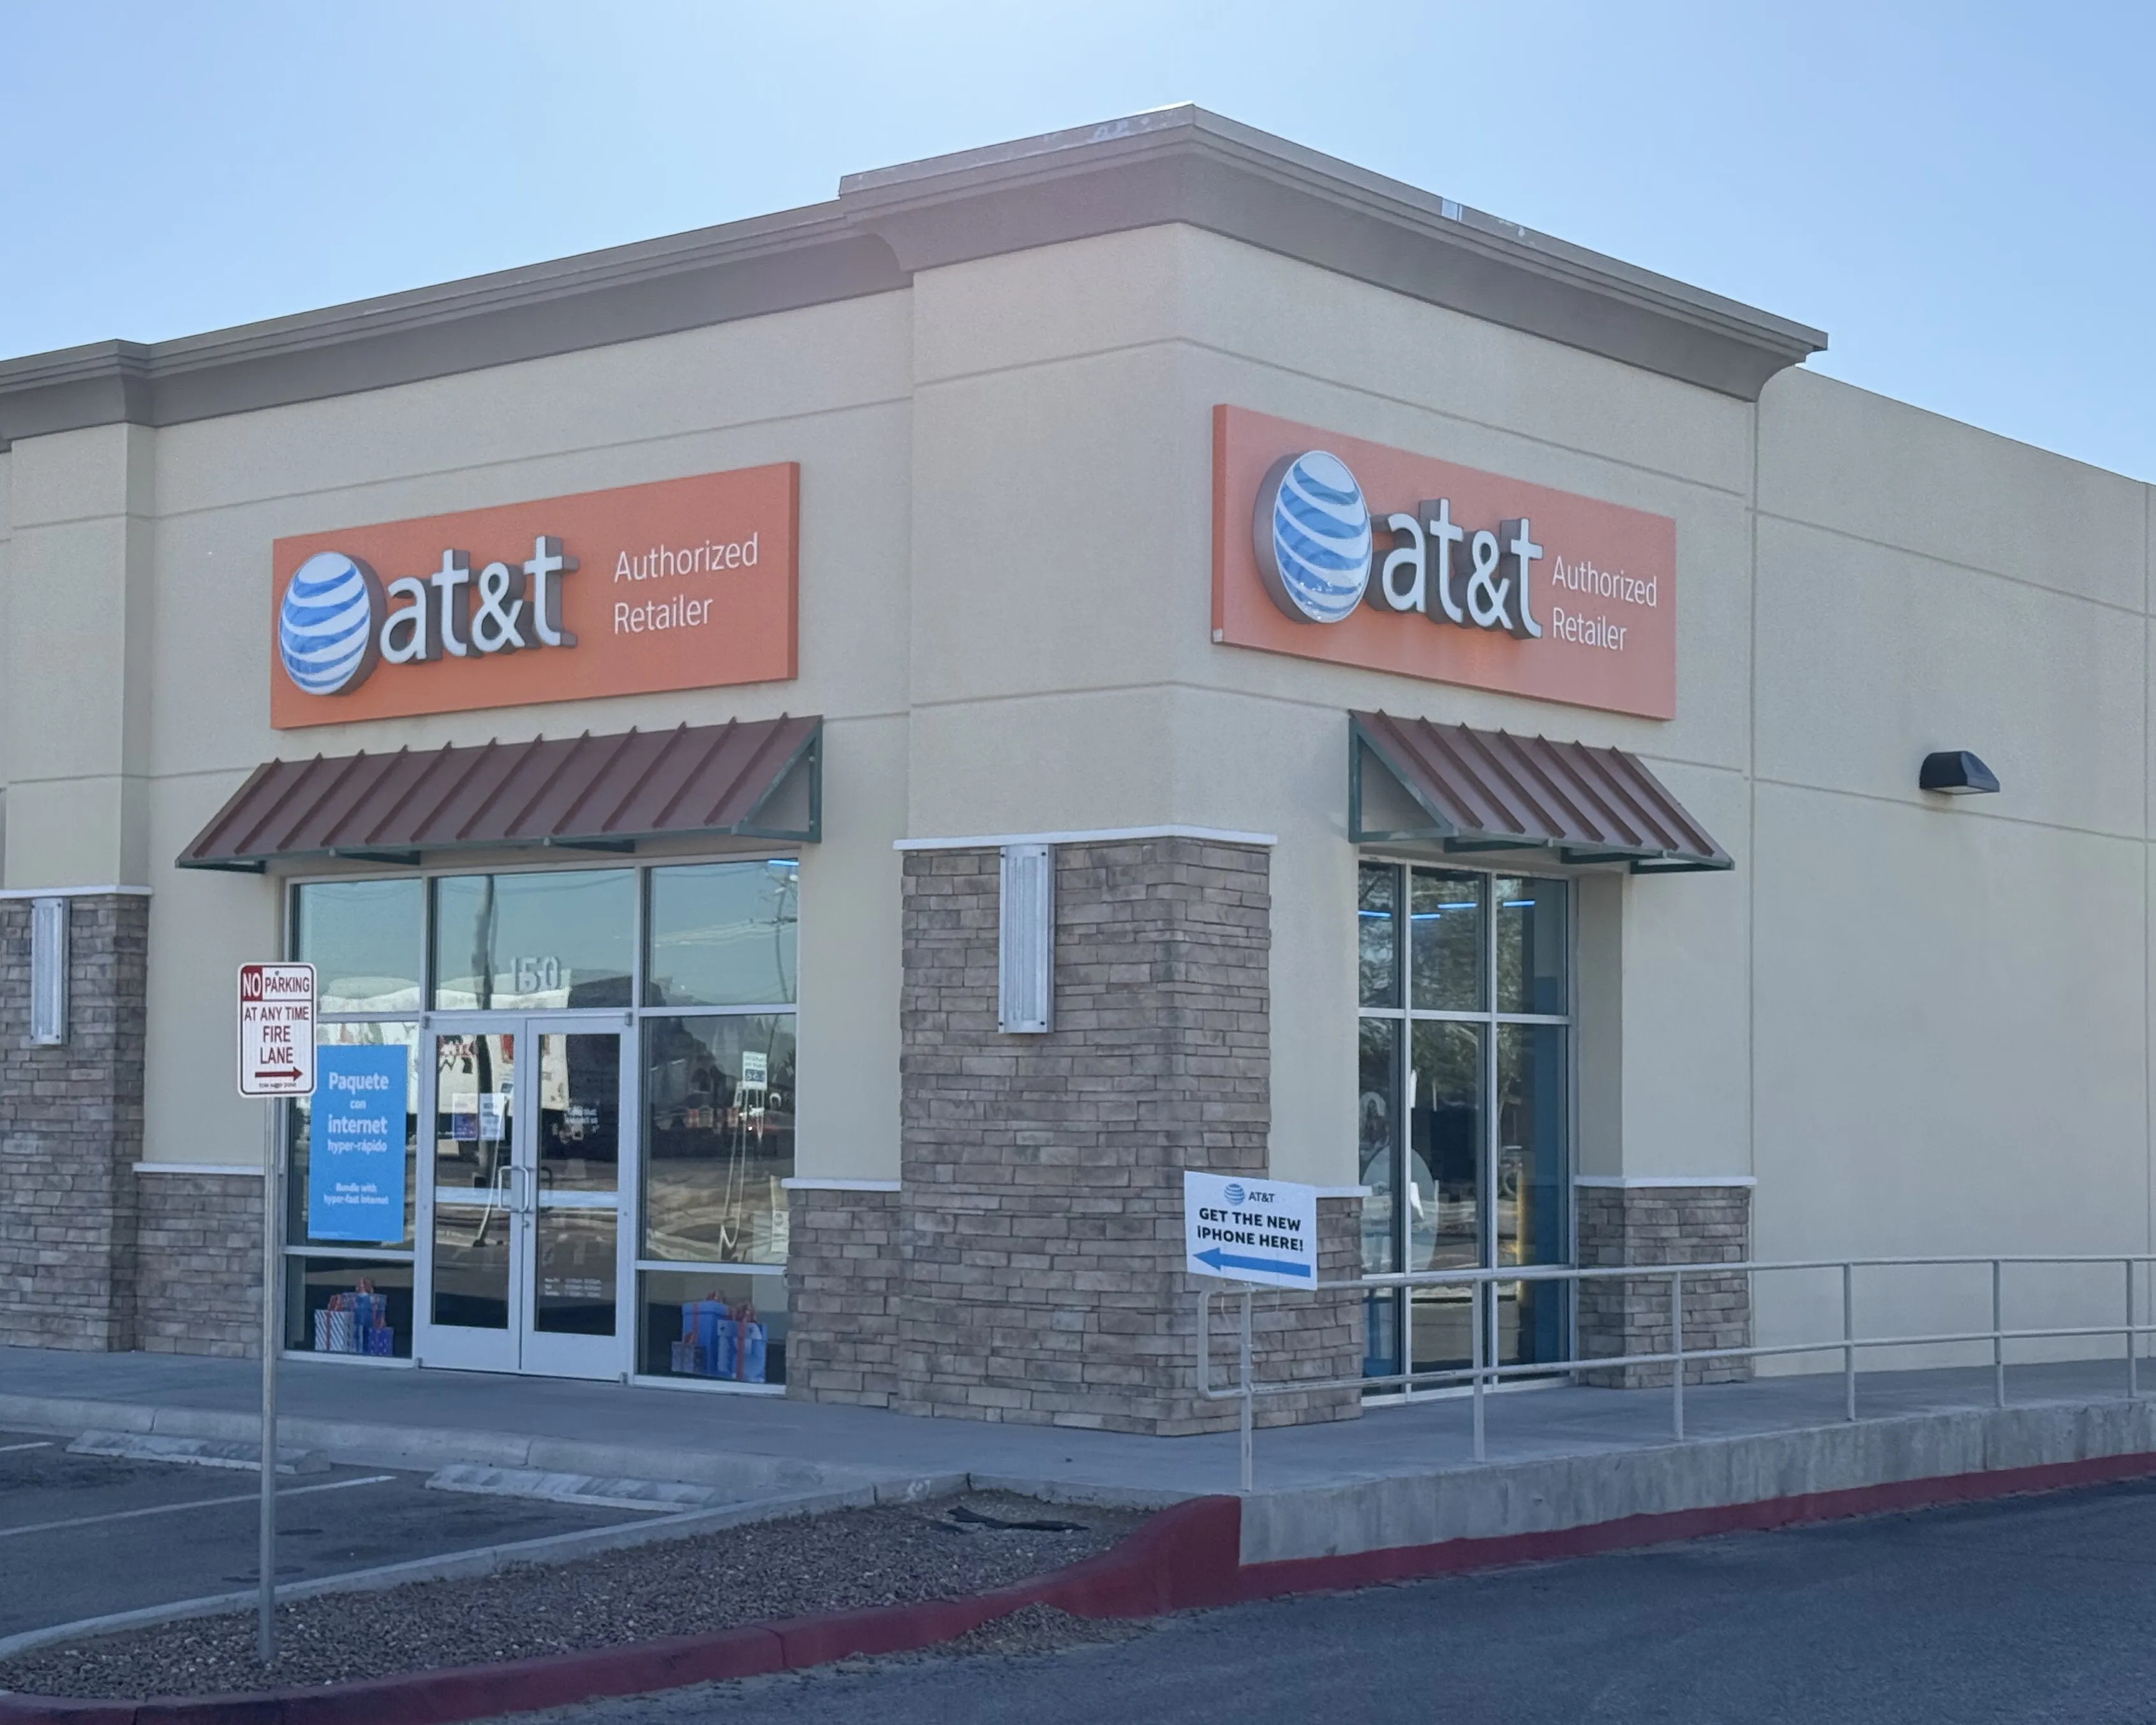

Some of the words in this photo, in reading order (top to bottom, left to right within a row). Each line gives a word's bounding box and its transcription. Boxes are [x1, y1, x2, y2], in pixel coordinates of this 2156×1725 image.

[614, 533, 759, 583] Authorized
[1382, 498, 1543, 639] at&t
[1552, 555, 1658, 608] Authorized
[380, 535, 564, 664] at&t
[614, 595, 714, 633] Retailer
[1552, 607, 1627, 651] Retailer
[242, 972, 261, 997] NO
[265, 977, 309, 993] PARKING
[244, 1007, 257, 1021] AT
[260, 1006, 282, 1021] ANY
[286, 1006, 309, 1021] TIME
[263, 1025, 291, 1042] FIRE
[260, 1047, 294, 1064] LANE
[329, 1071, 389, 1095] Paquete
[350, 1100, 366, 1109] con
[328, 1113, 388, 1134] internet
[1248, 1191, 1275, 1203] AT&T
[1199, 1208, 1228, 1223] GET
[1232, 1211, 1262, 1227] THE
[1267, 1215, 1301, 1231] NEW
[1260, 1234, 1304, 1252] HERE!
